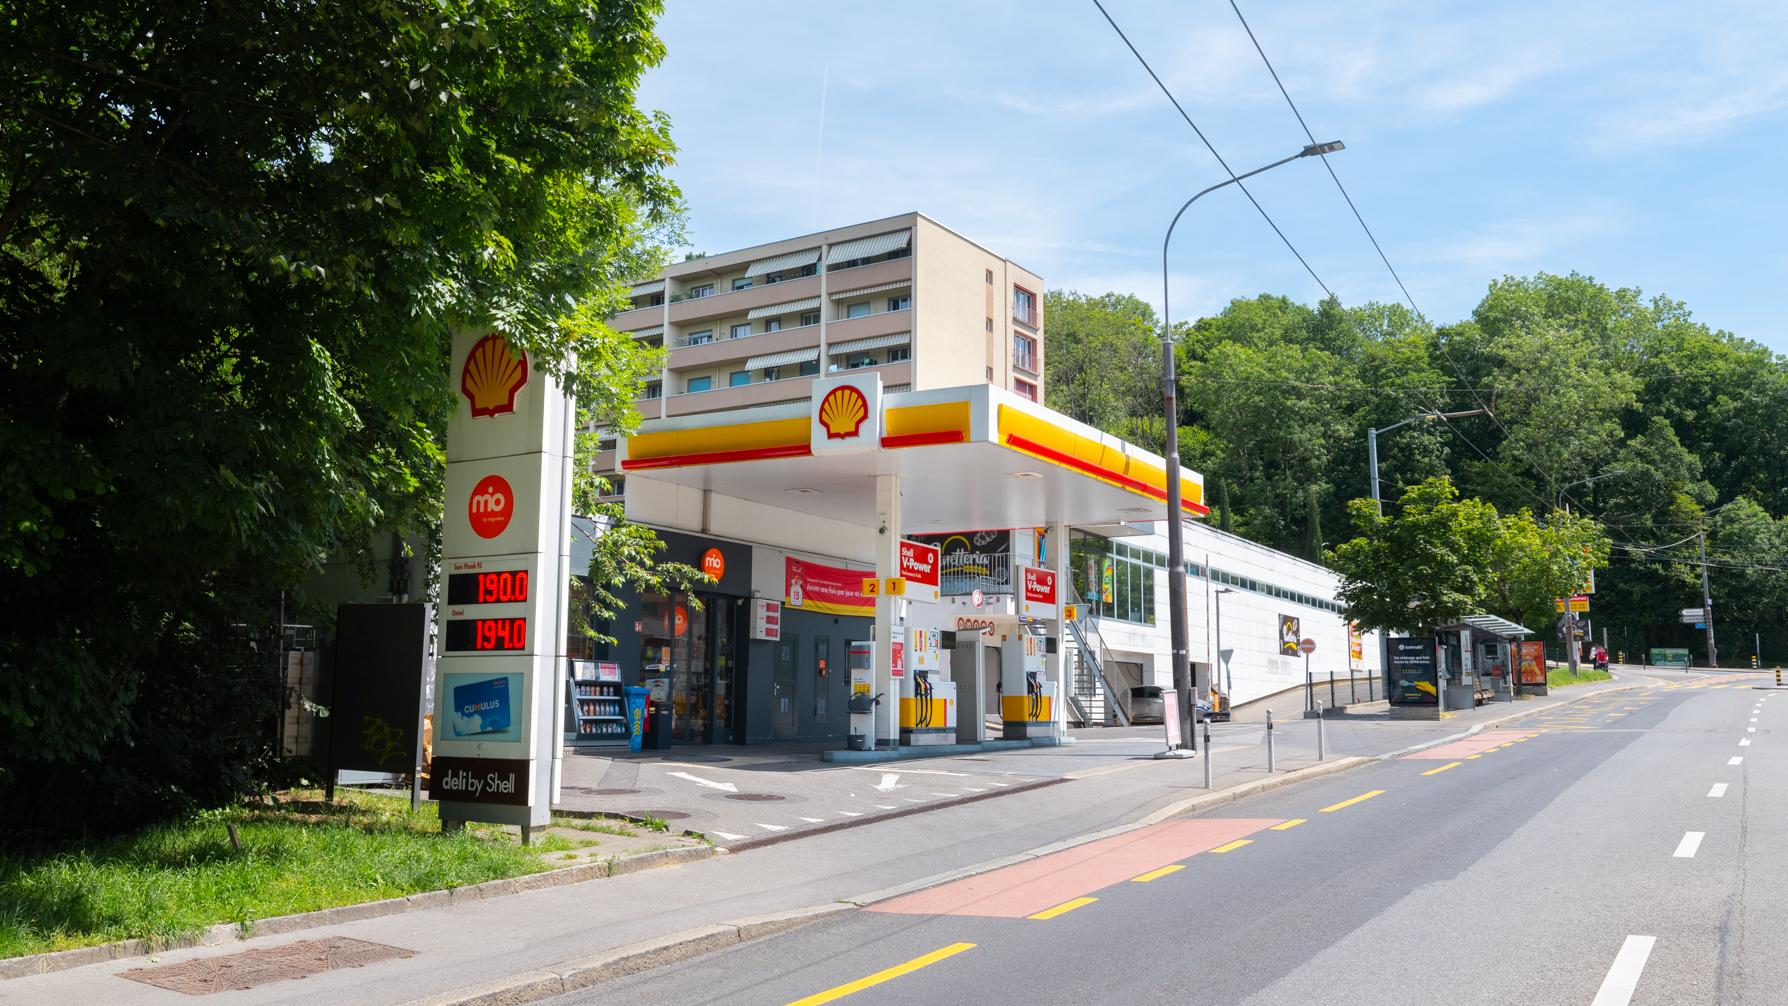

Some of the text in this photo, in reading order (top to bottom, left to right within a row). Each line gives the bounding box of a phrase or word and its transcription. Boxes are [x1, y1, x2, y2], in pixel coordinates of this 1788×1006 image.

[472, 486, 505, 513] mio
[902, 547, 913, 557] Shell
[706, 554, 721, 568] mio
[902, 556, 931, 573] V-Power
[1027, 572, 1036, 580] Shell
[478, 571, 528, 603] 190.0
[837, 589, 846, 597] par
[869, 583, 876, 593] 2
[892, 582, 896, 591] 1
[1027, 580, 1050, 594] V-Power
[452, 609, 464, 617] Diesel
[1066, 609, 1072, 618] 3
[476, 619, 527, 650] 194.0
[464, 699, 500, 714] CUMULUS
[442, 769, 515, 797] deli by Shell
